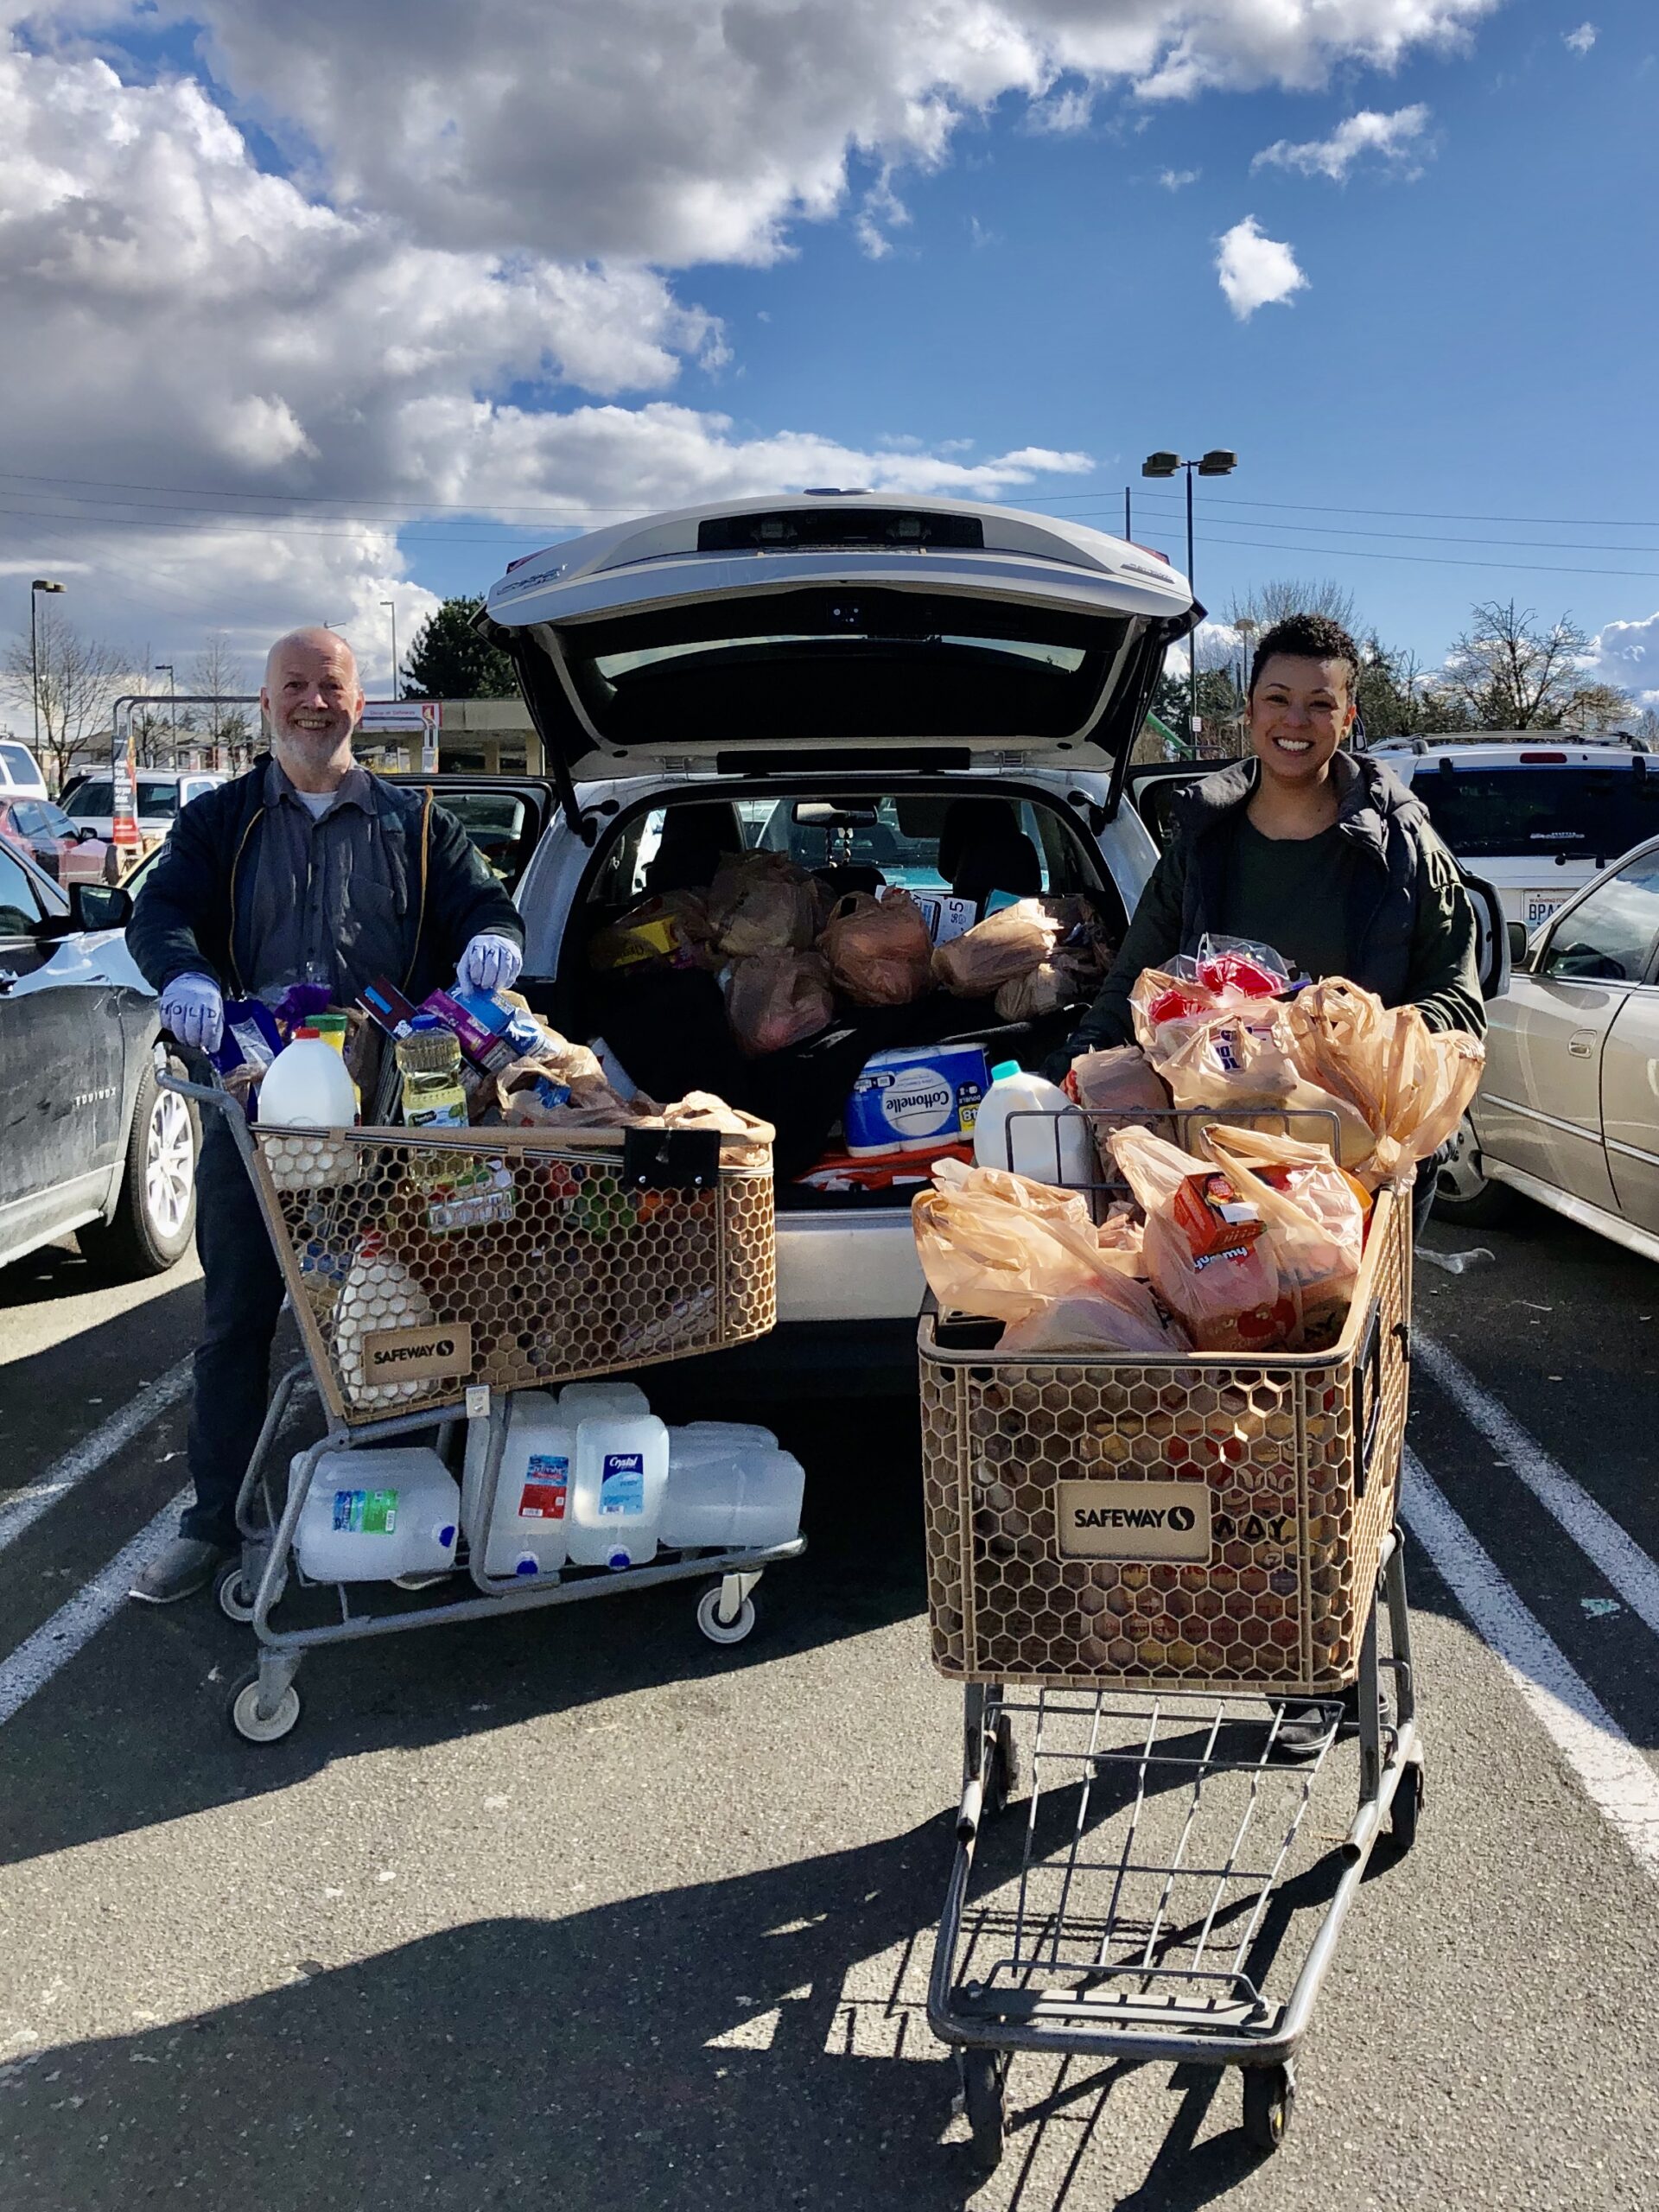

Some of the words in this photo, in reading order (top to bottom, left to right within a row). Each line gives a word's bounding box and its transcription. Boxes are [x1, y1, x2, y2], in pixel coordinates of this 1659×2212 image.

[1529, 904, 1563, 921] BPA
[161, 1003, 217, 1018] HOLD
[886, 1090, 950, 1113] Cottonelle
[374, 1344, 435, 1365] SAFEWAY
[609, 1456, 639, 1469] Crystal
[1074, 1509, 1166, 1528] SAFEWAY
